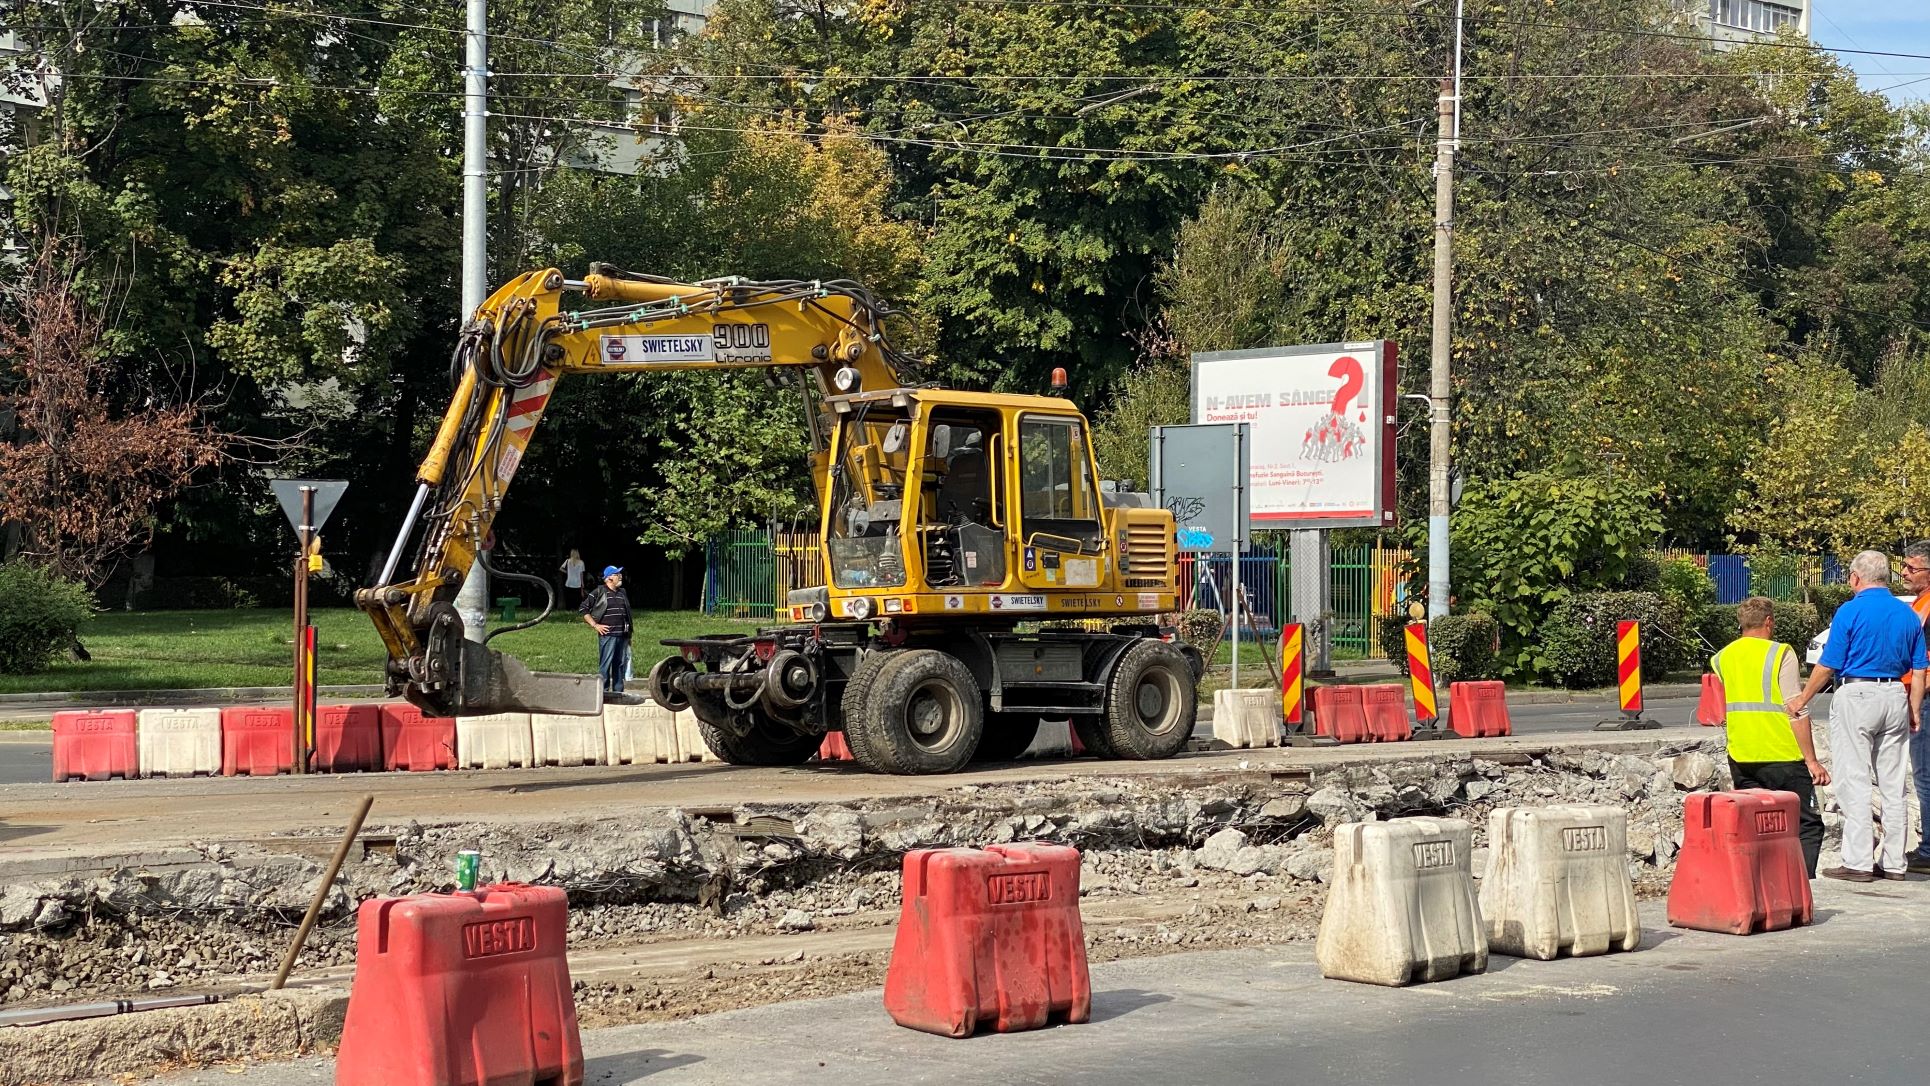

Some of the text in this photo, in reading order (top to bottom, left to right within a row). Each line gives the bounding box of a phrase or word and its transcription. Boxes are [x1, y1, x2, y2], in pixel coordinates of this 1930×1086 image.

[713, 323, 769, 349] 900
[642, 338, 703, 354] SWIETELSKY
[715, 353, 772, 364] Litronic
[1206, 392, 1271, 411] N-AVEM
[1206, 413, 1239, 422] Donează
[1011, 596, 1044, 605] SWIETELSKY
[1061, 598, 1101, 608] SWIETELSKY
[80, 718, 113, 731] VESTA
[165, 717, 199, 730] VESTA
[247, 714, 281, 727] VESTA
[1755, 810, 1787, 833] VESTA
[1564, 826, 1607, 851] VESTA
[1413, 841, 1454, 869] VESTA
[989, 872, 1049, 905] VESTA
[464, 918, 532, 956] VESTA
